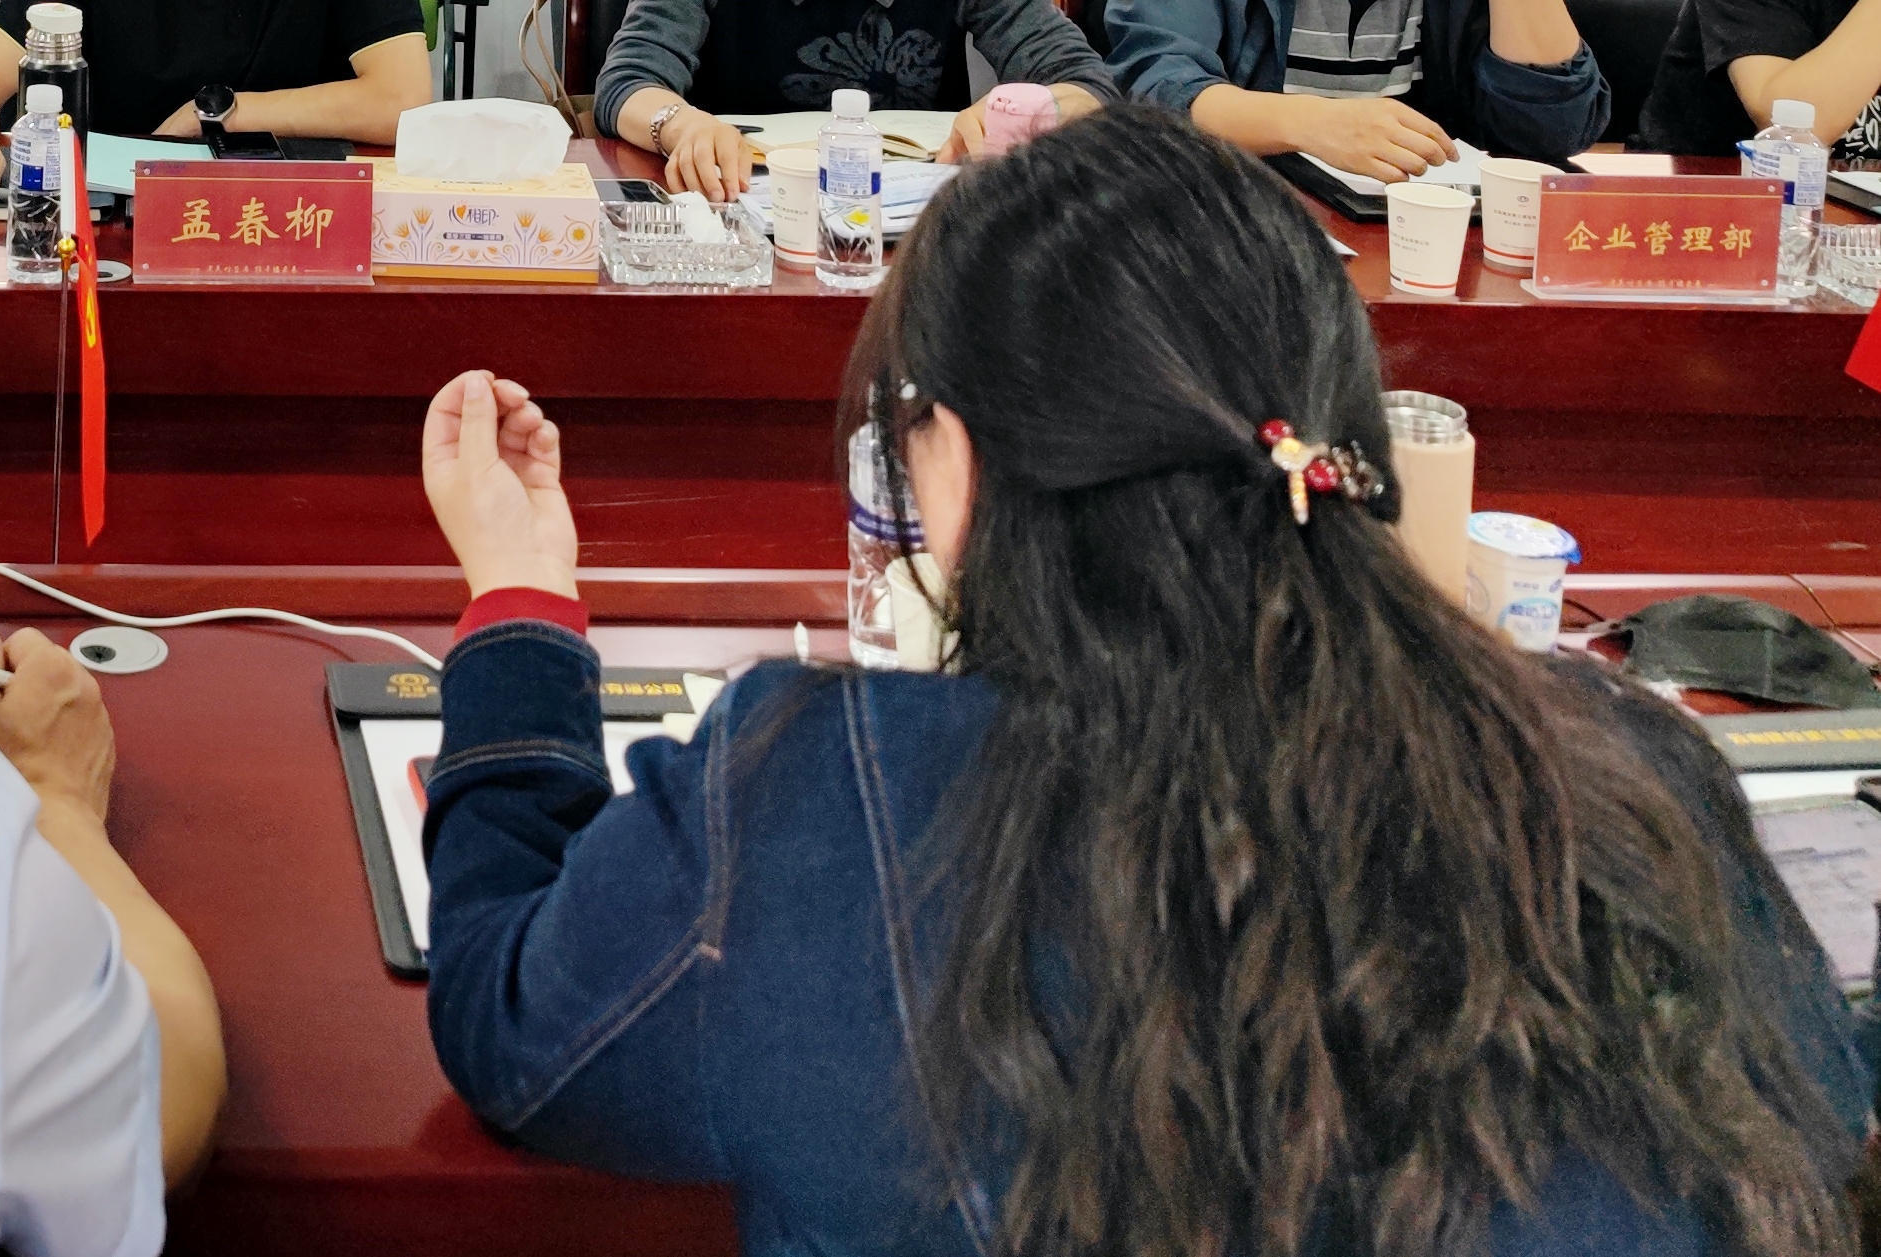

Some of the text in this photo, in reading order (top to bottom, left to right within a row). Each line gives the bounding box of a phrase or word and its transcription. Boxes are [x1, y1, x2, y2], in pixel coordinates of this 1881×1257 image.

[171, 196, 334, 249] 孟春柳
[1564, 220, 1752, 258] 企业管理部
